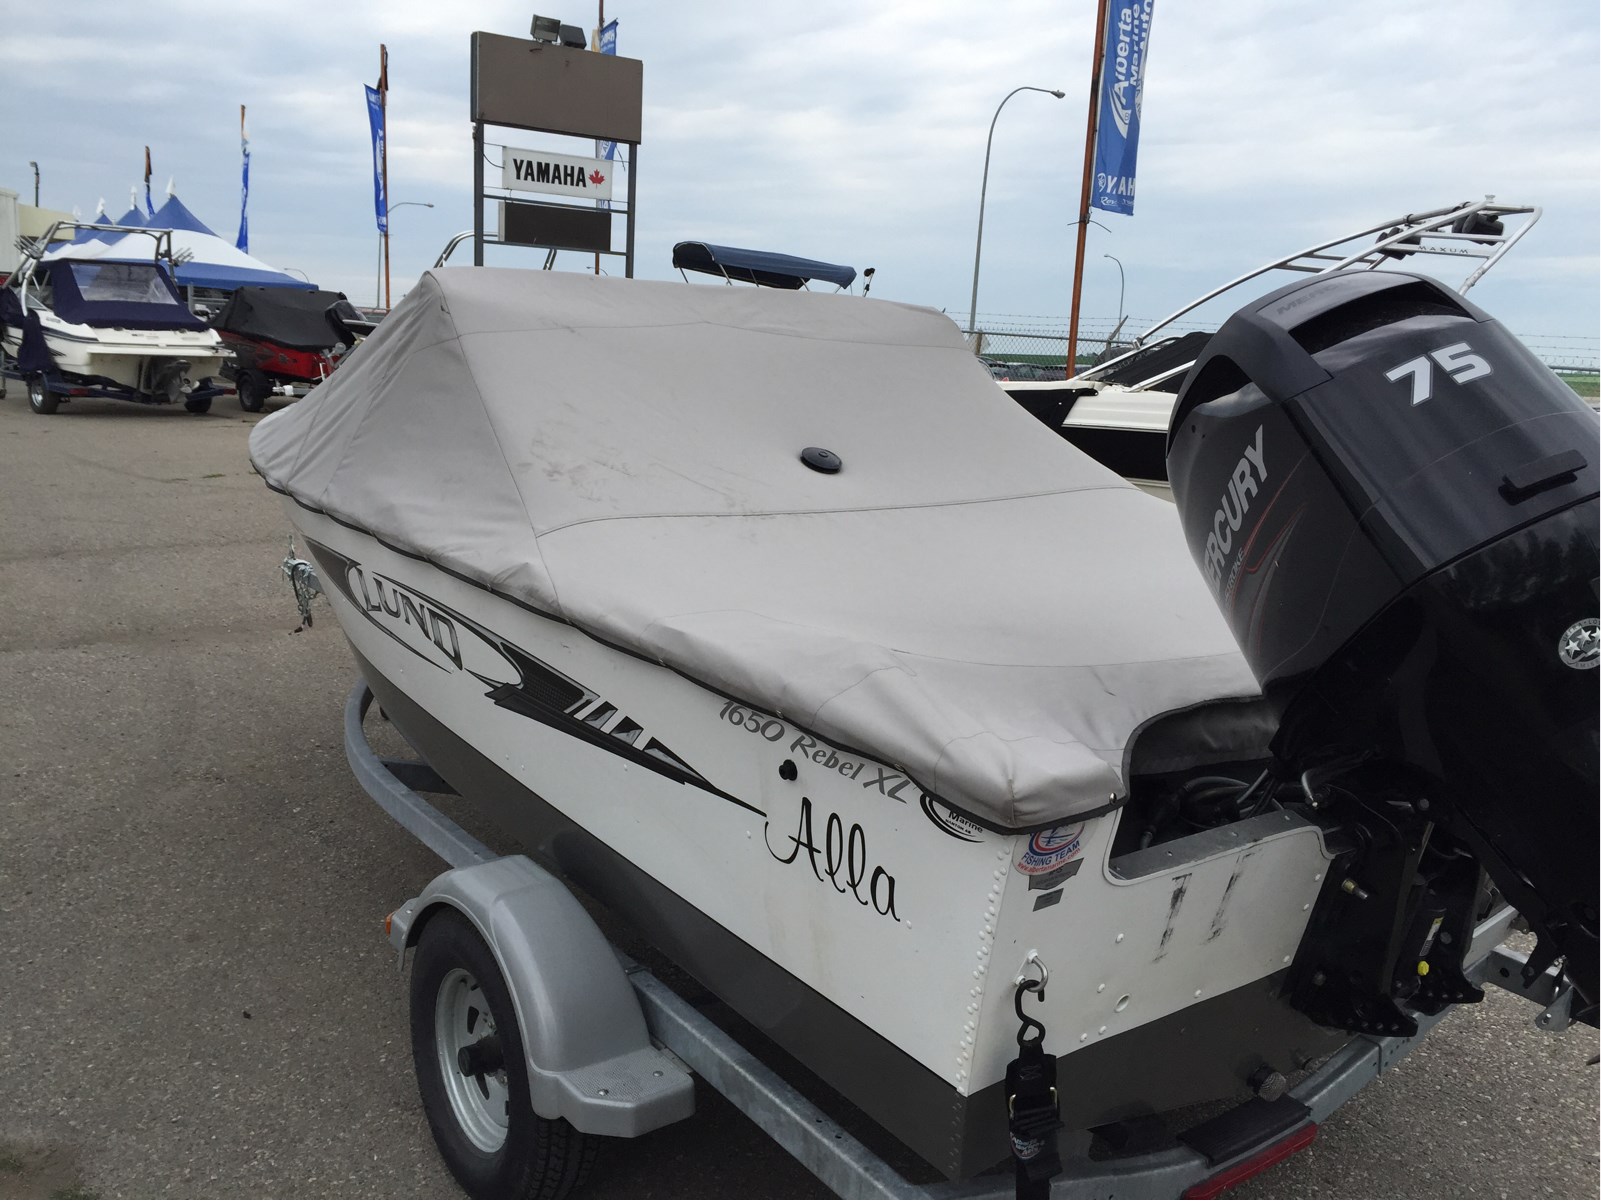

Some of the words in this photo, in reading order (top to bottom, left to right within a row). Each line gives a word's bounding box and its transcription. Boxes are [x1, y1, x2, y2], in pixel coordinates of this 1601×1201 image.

[1130, 3, 1140, 86] Marine
[513, 158, 587, 188] YAMAHA
[1418, 245, 1469, 255] MAXUM
[1384, 341, 1494, 406] 75
[1204, 424, 1268, 602] ERCURY
[356, 566, 463, 671] LUND
[719, 700, 785, 742] 1650
[789, 734, 866, 781] Rebel
[862, 767, 913, 804] XL
[764, 797, 901, 922] Alla
[948, 811, 984, 834] Marine
[1021, 852, 1052, 866] FISHING
[1055, 840, 1080, 862] TEAM
